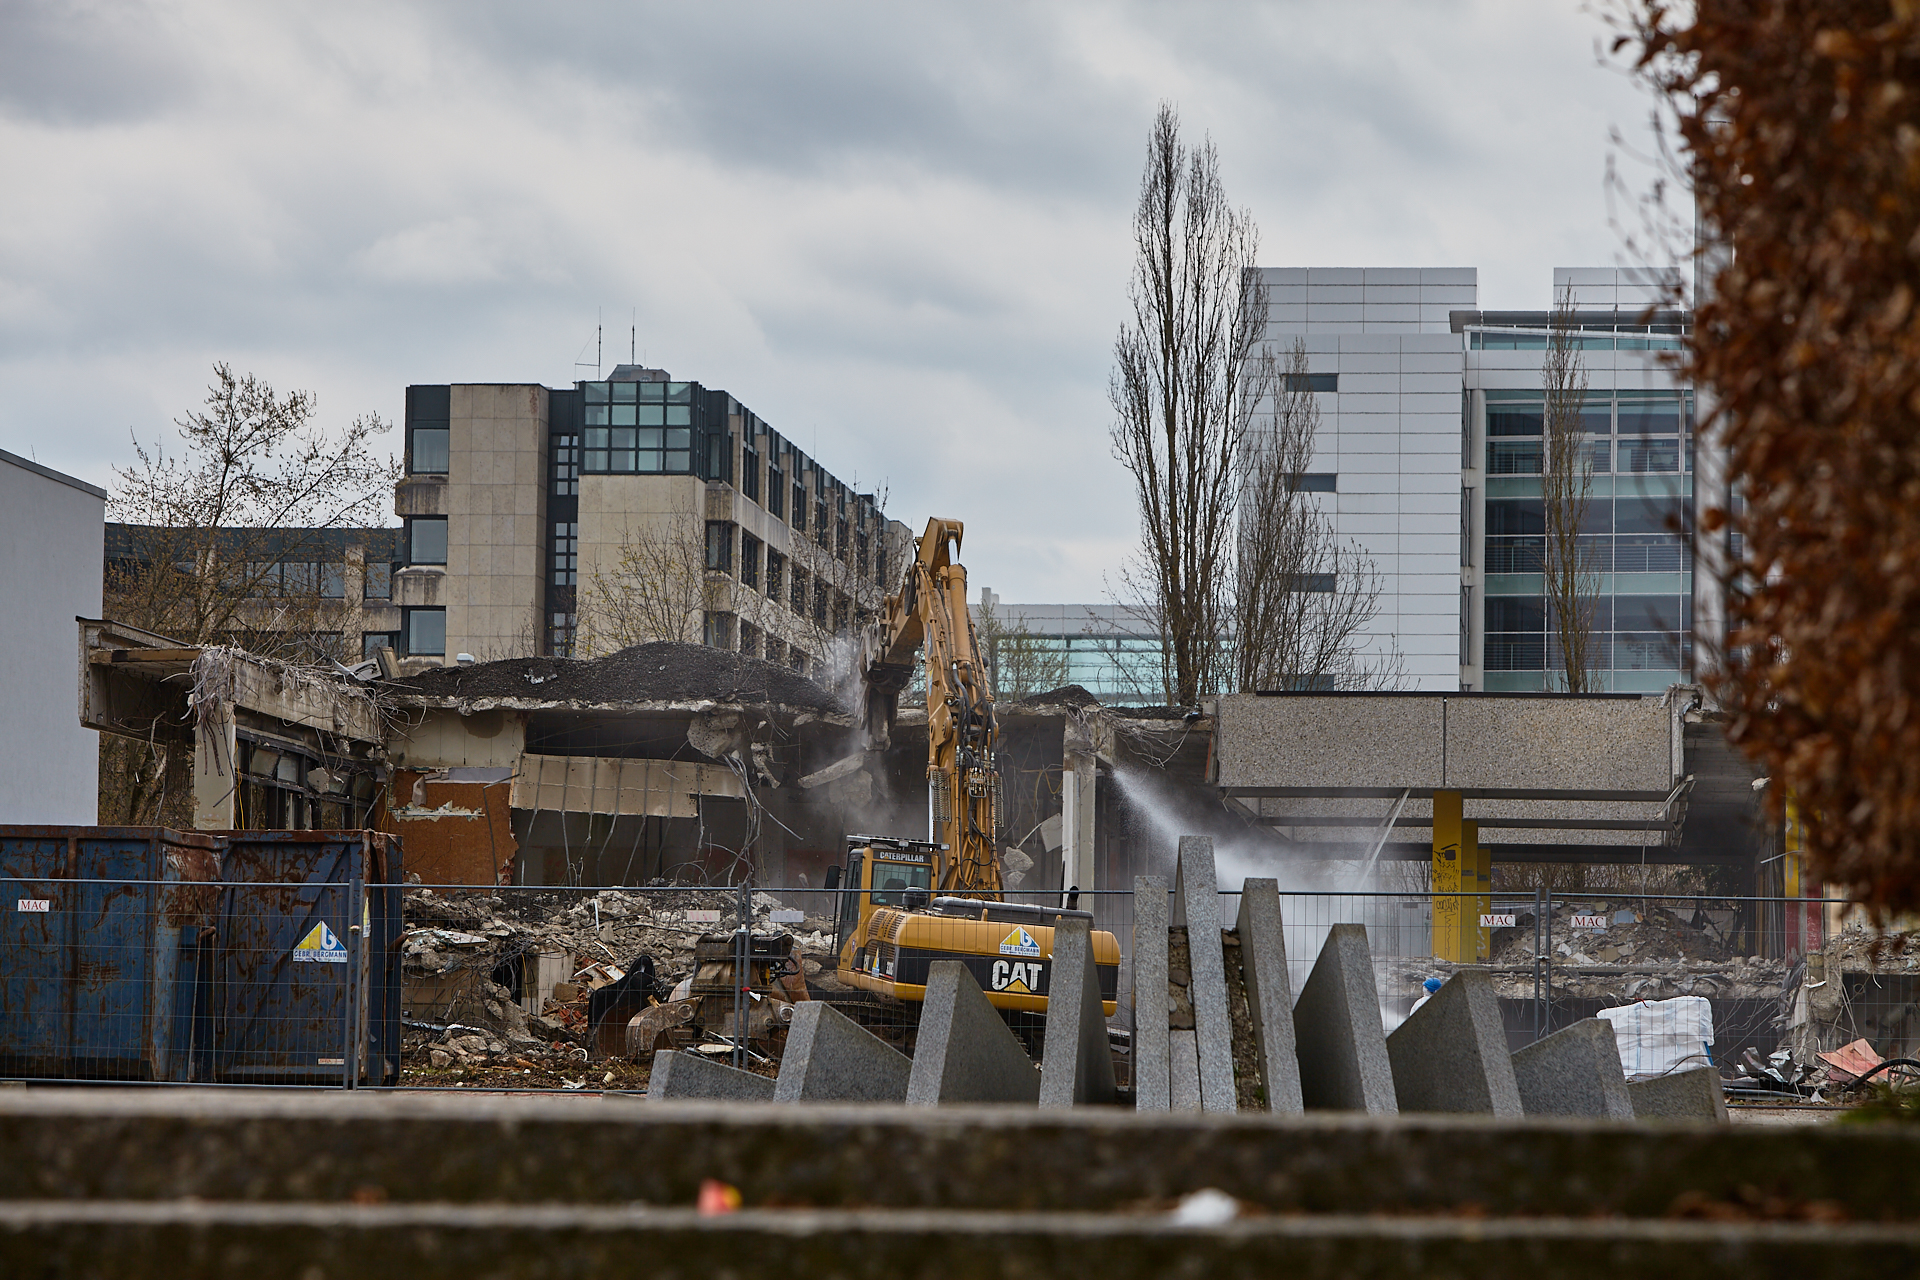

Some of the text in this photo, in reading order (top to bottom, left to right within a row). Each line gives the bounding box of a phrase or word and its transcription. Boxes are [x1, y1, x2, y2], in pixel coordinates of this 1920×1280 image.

[880, 851, 924, 862] CATERPILLAR
[21, 900, 47, 910] MAC
[1484, 915, 1513, 925] MAC
[1575, 916, 1604, 927] MAC
[313, 950, 348, 958] BERGMANN
[991, 960, 1043, 990] CAT
